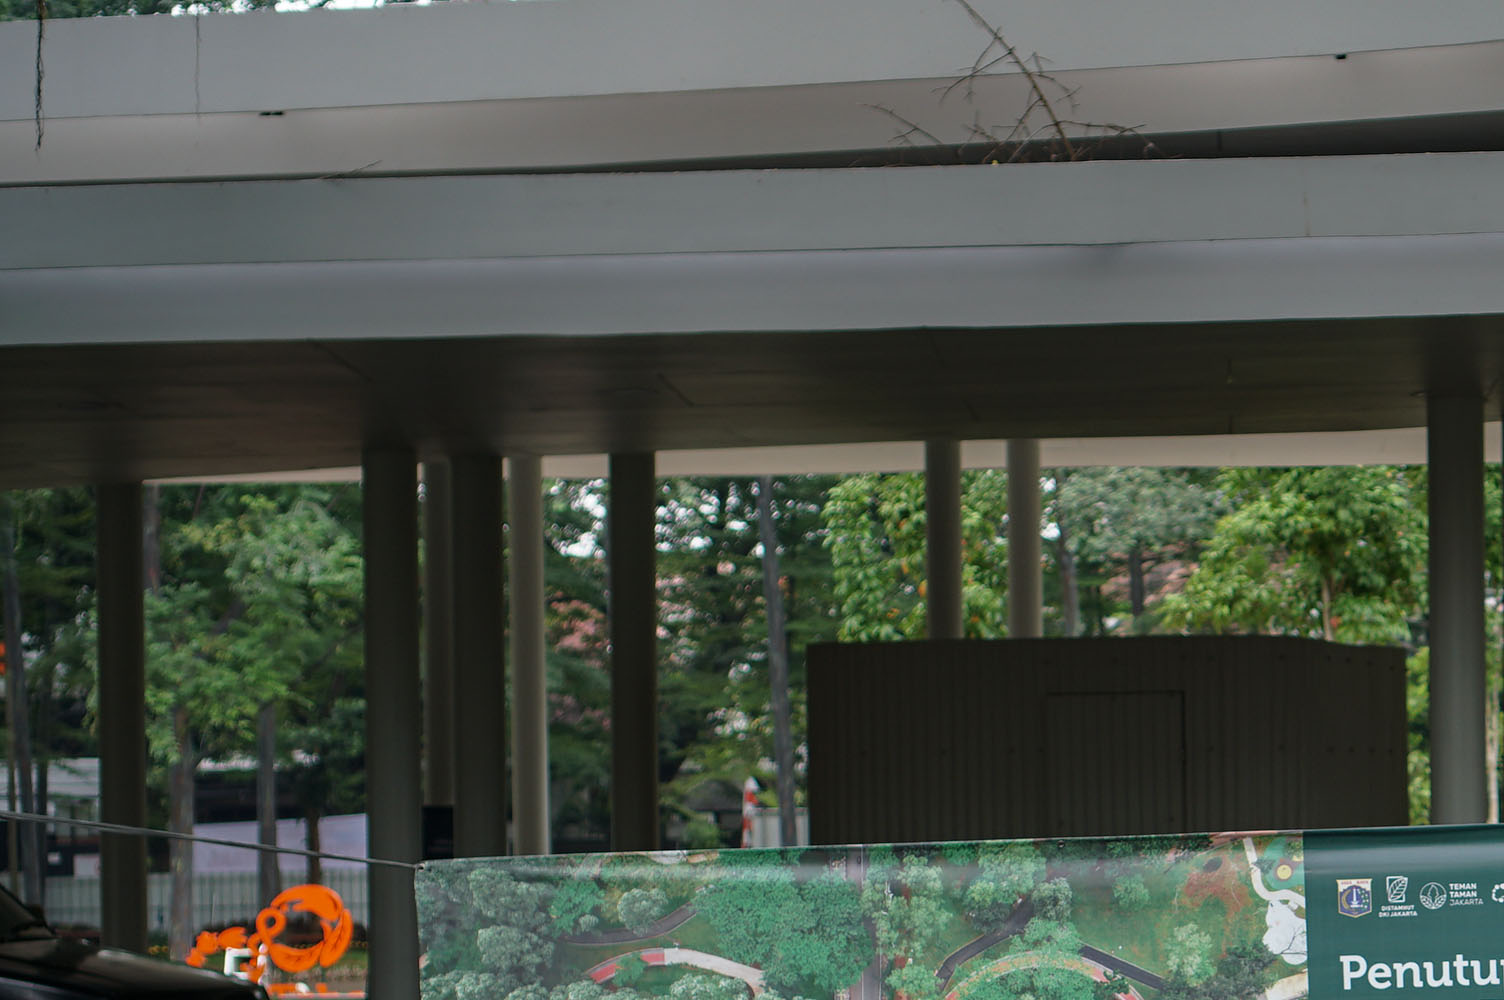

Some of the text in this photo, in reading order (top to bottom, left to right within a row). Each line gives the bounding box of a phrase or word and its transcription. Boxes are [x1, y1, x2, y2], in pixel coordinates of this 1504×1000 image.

[1449, 882, 1477, 891] TEMAN
[1449, 890, 1477, 898] TAMAN
[1449, 898, 1484, 907] JAKARTA
